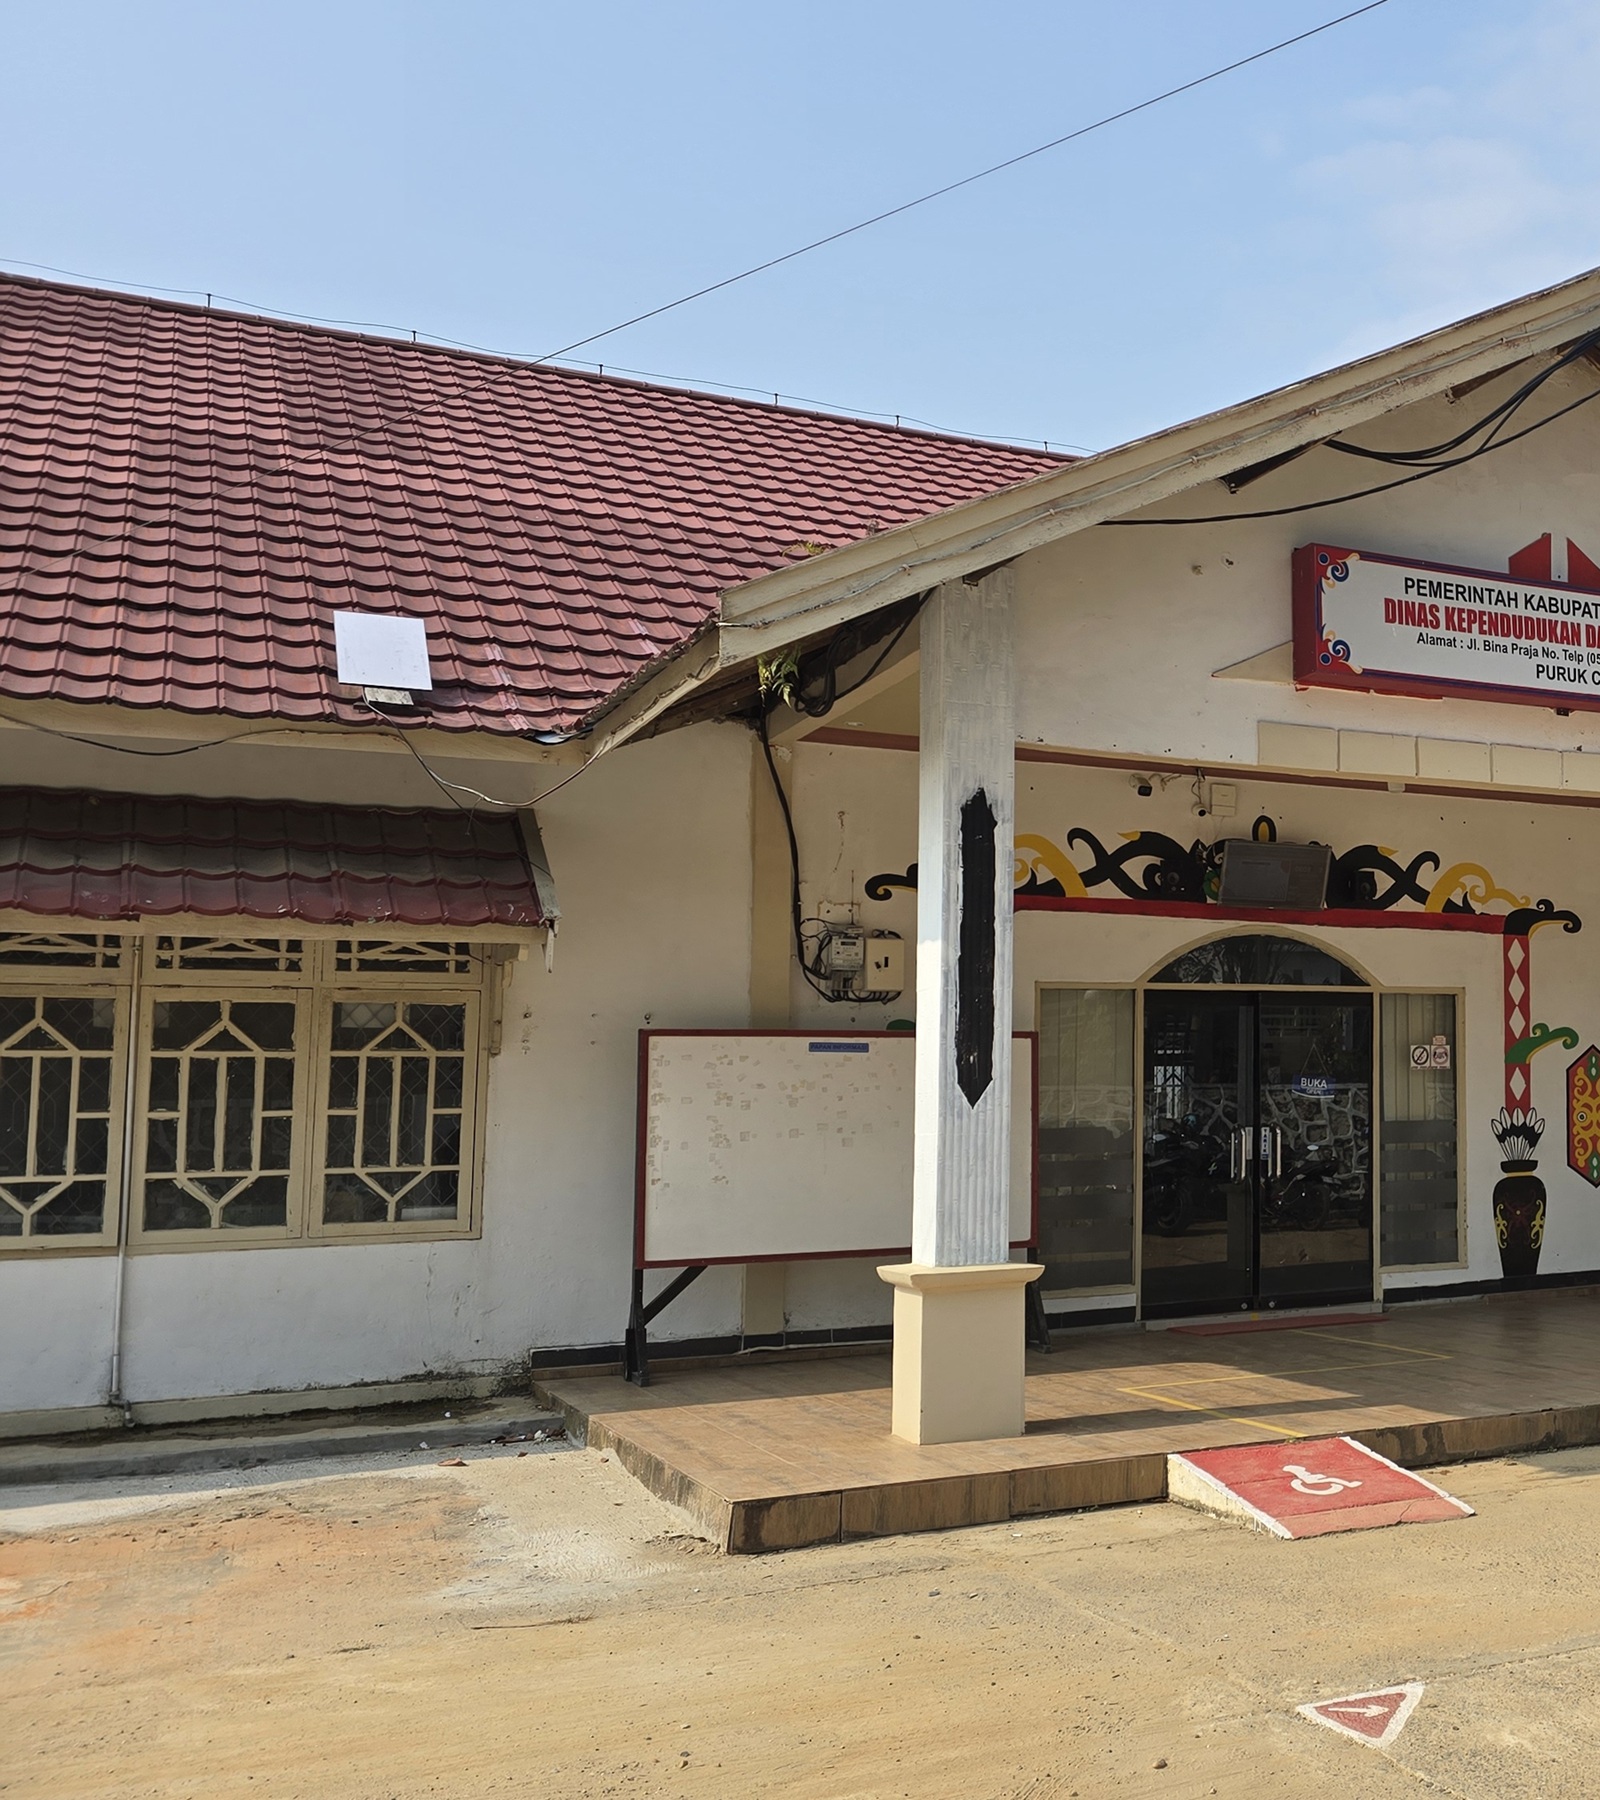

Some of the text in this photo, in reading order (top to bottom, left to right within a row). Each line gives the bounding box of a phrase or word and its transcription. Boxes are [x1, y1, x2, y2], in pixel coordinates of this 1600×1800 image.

[1404, 577, 1519, 609] PEMERINTAH
[1384, 597, 1440, 629] DINAS
[1444, 605, 1581, 647] KEPENDUDUKAN
[1416, 632, 1457, 648] Alamat
[1466, 638, 1480, 651] Jl.
[1483, 639, 1508, 654] Bina
[1511, 643, 1539, 659] Praja
[1541, 646, 1560, 660] No.
[1562, 649, 1584, 665] Telp
[1536, 663, 1588, 685] PURUK
[1300, 1077, 1327, 1089] BUKA
